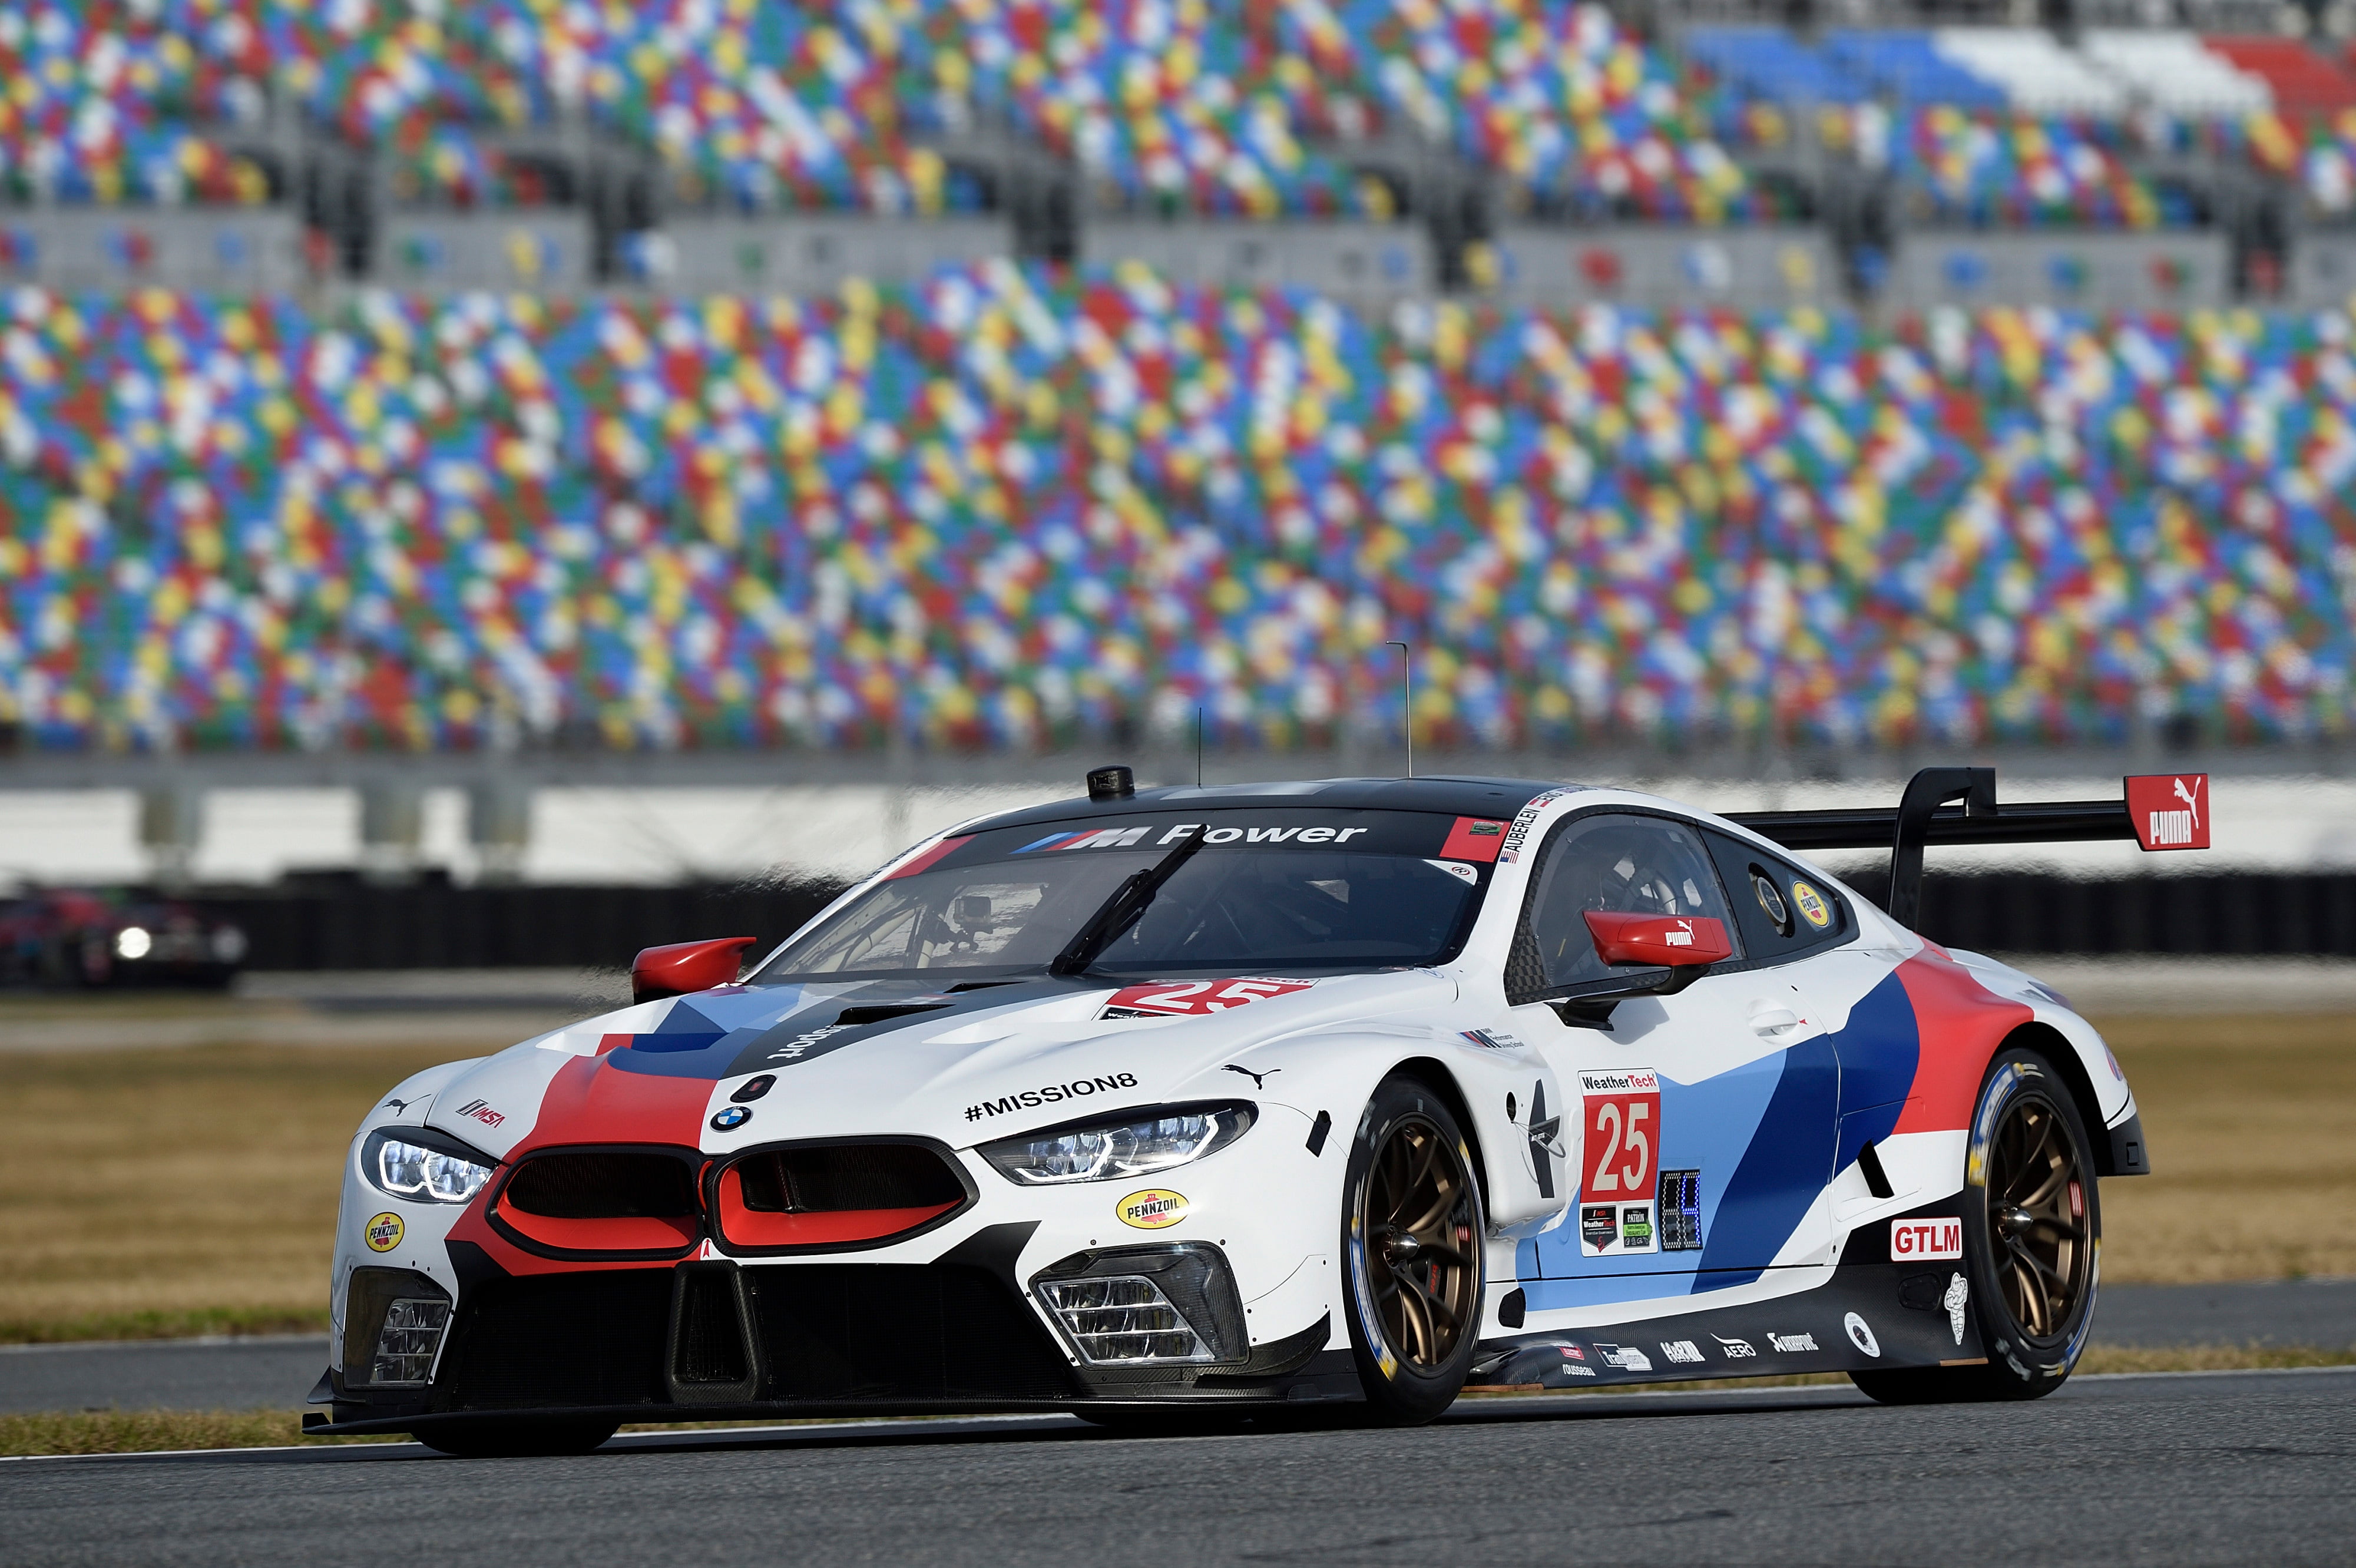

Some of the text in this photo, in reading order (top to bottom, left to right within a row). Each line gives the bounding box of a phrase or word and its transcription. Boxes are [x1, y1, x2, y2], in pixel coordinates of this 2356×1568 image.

[1156, 823, 1368, 845] Power
[1504, 808, 1540, 852] AUBERLEN
[2149, 810, 2192, 845] PUMA
[1801, 895, 1821, 911] PENNZOIL
[1665, 931, 1693, 946] PUMA
[1582, 1074, 1656, 1090] WeatherTech
[964, 1073, 1139, 1122] #MISSION8
[1591, 1102, 1649, 1192] 25
[1127, 1197, 1180, 1219] PENNZOIL
[369, 1223, 400, 1240] PENNZOIL
[1895, 1225, 1960, 1254] GTLM
[1723, 1345, 1757, 1358] AERO
[1562, 1364, 1596, 1377] rousseau
